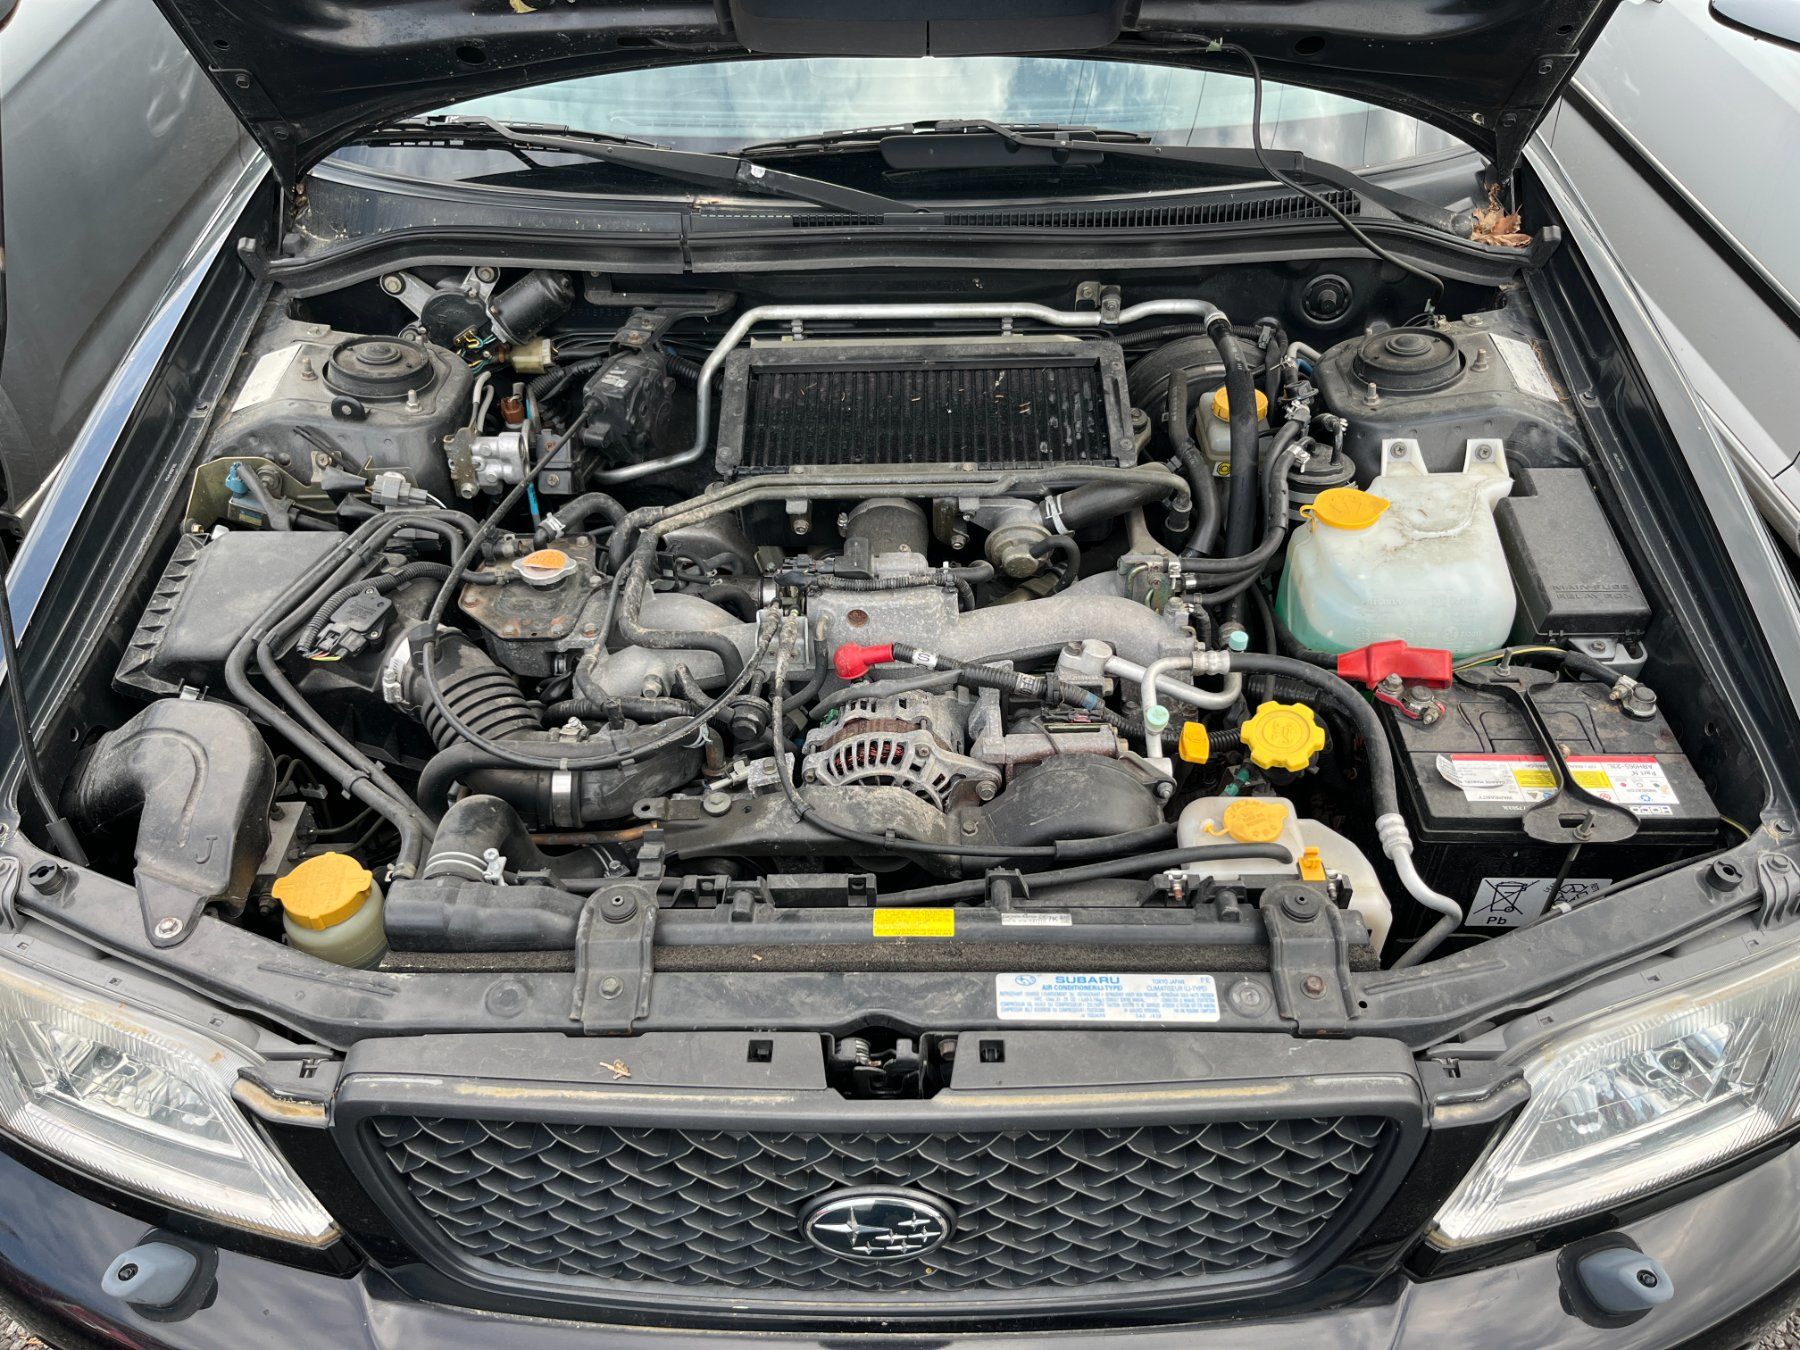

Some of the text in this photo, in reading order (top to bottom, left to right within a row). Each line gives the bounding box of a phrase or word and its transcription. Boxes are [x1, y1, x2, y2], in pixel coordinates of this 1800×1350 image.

[194, 834, 218, 864] J
[1486, 916, 1507, 924] Pb
[1055, 976, 1120, 984] SUBARU
